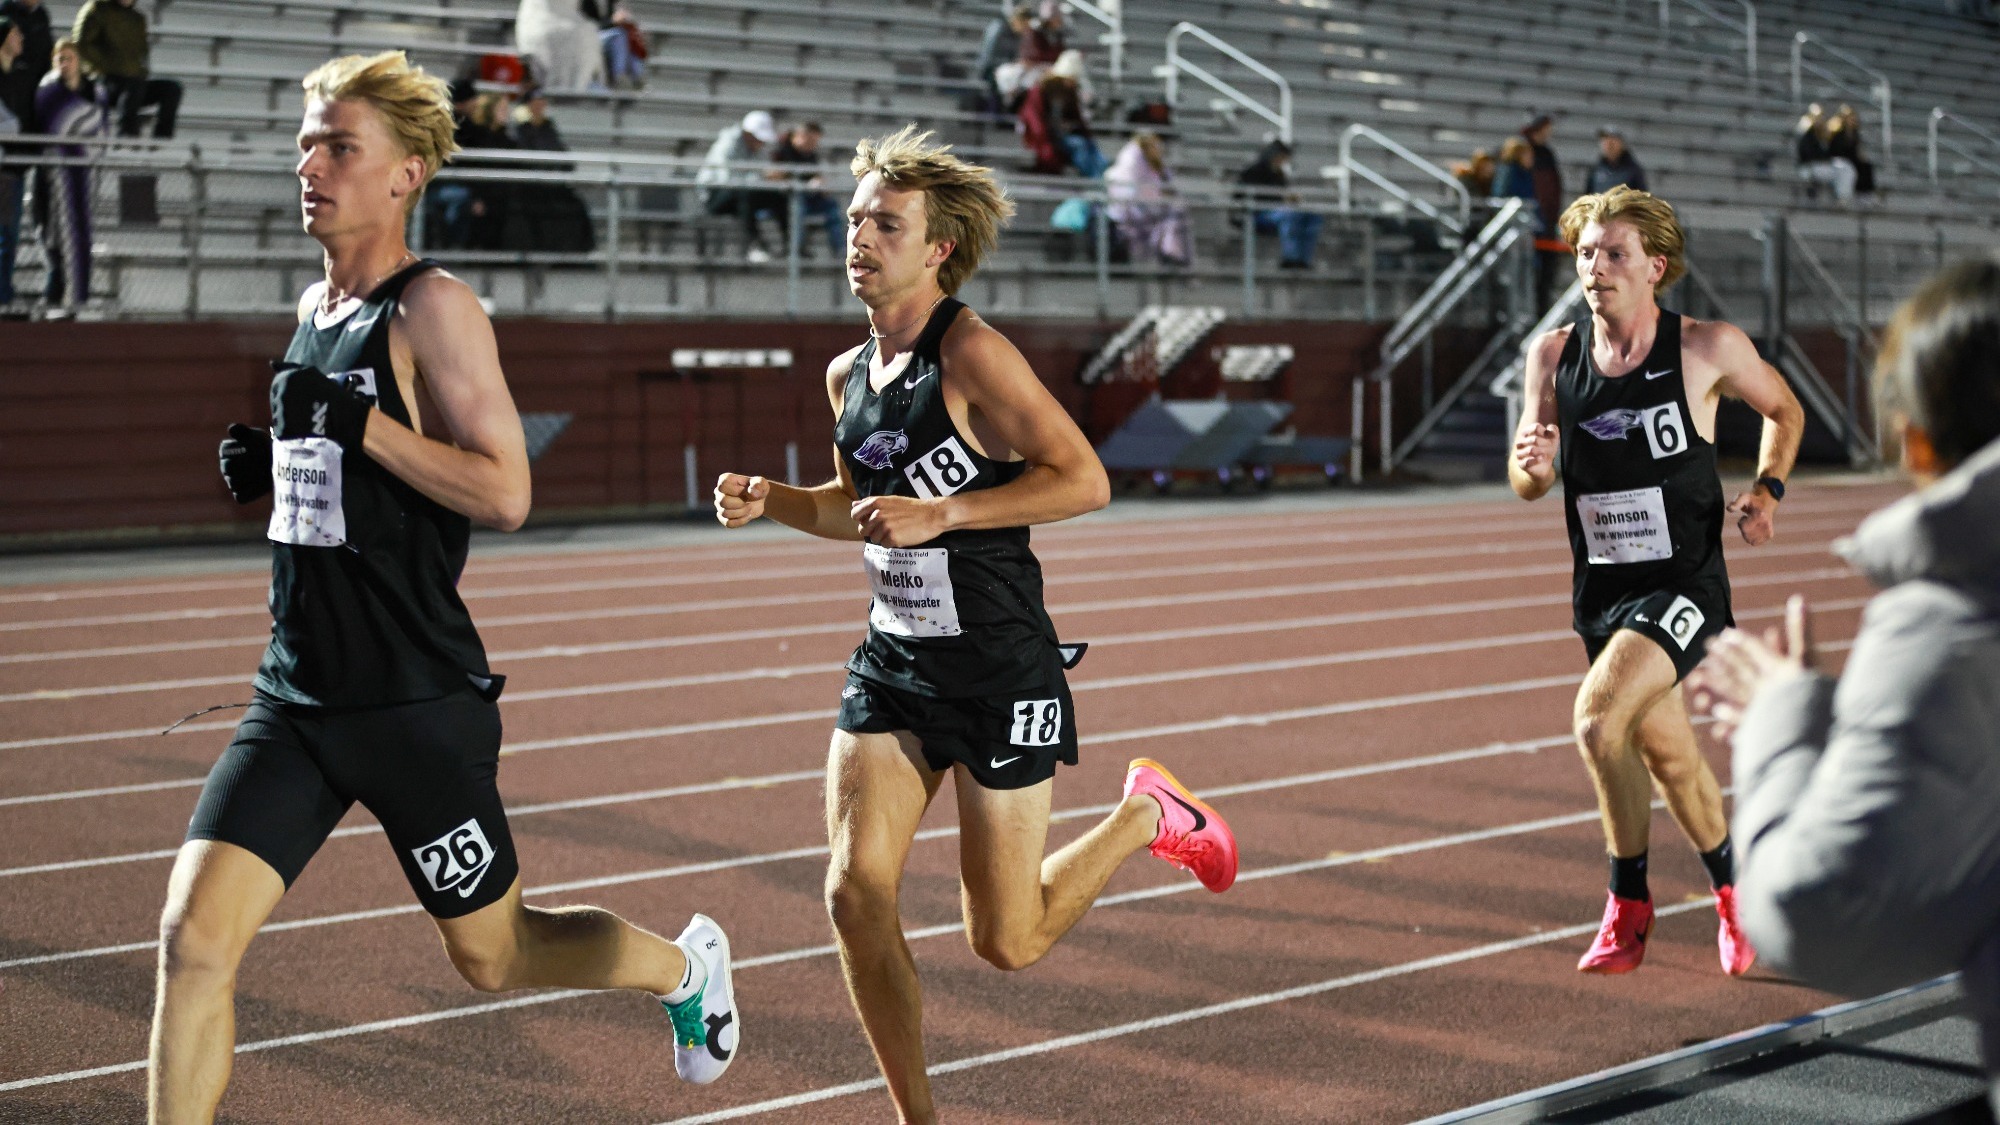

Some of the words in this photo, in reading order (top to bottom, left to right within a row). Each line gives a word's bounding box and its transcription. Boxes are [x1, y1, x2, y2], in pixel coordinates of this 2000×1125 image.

[1653, 408, 1679, 453] 6
[911, 447, 967, 498] 18
[1593, 528, 1657, 541] UW-Whitewater
[1594, 510, 1649, 526] Johnson
[880, 569, 924, 589] Metko
[1670, 606, 1698, 639] 6
[1018, 702, 1057, 743] 18
[421, 828, 483, 889] 26
